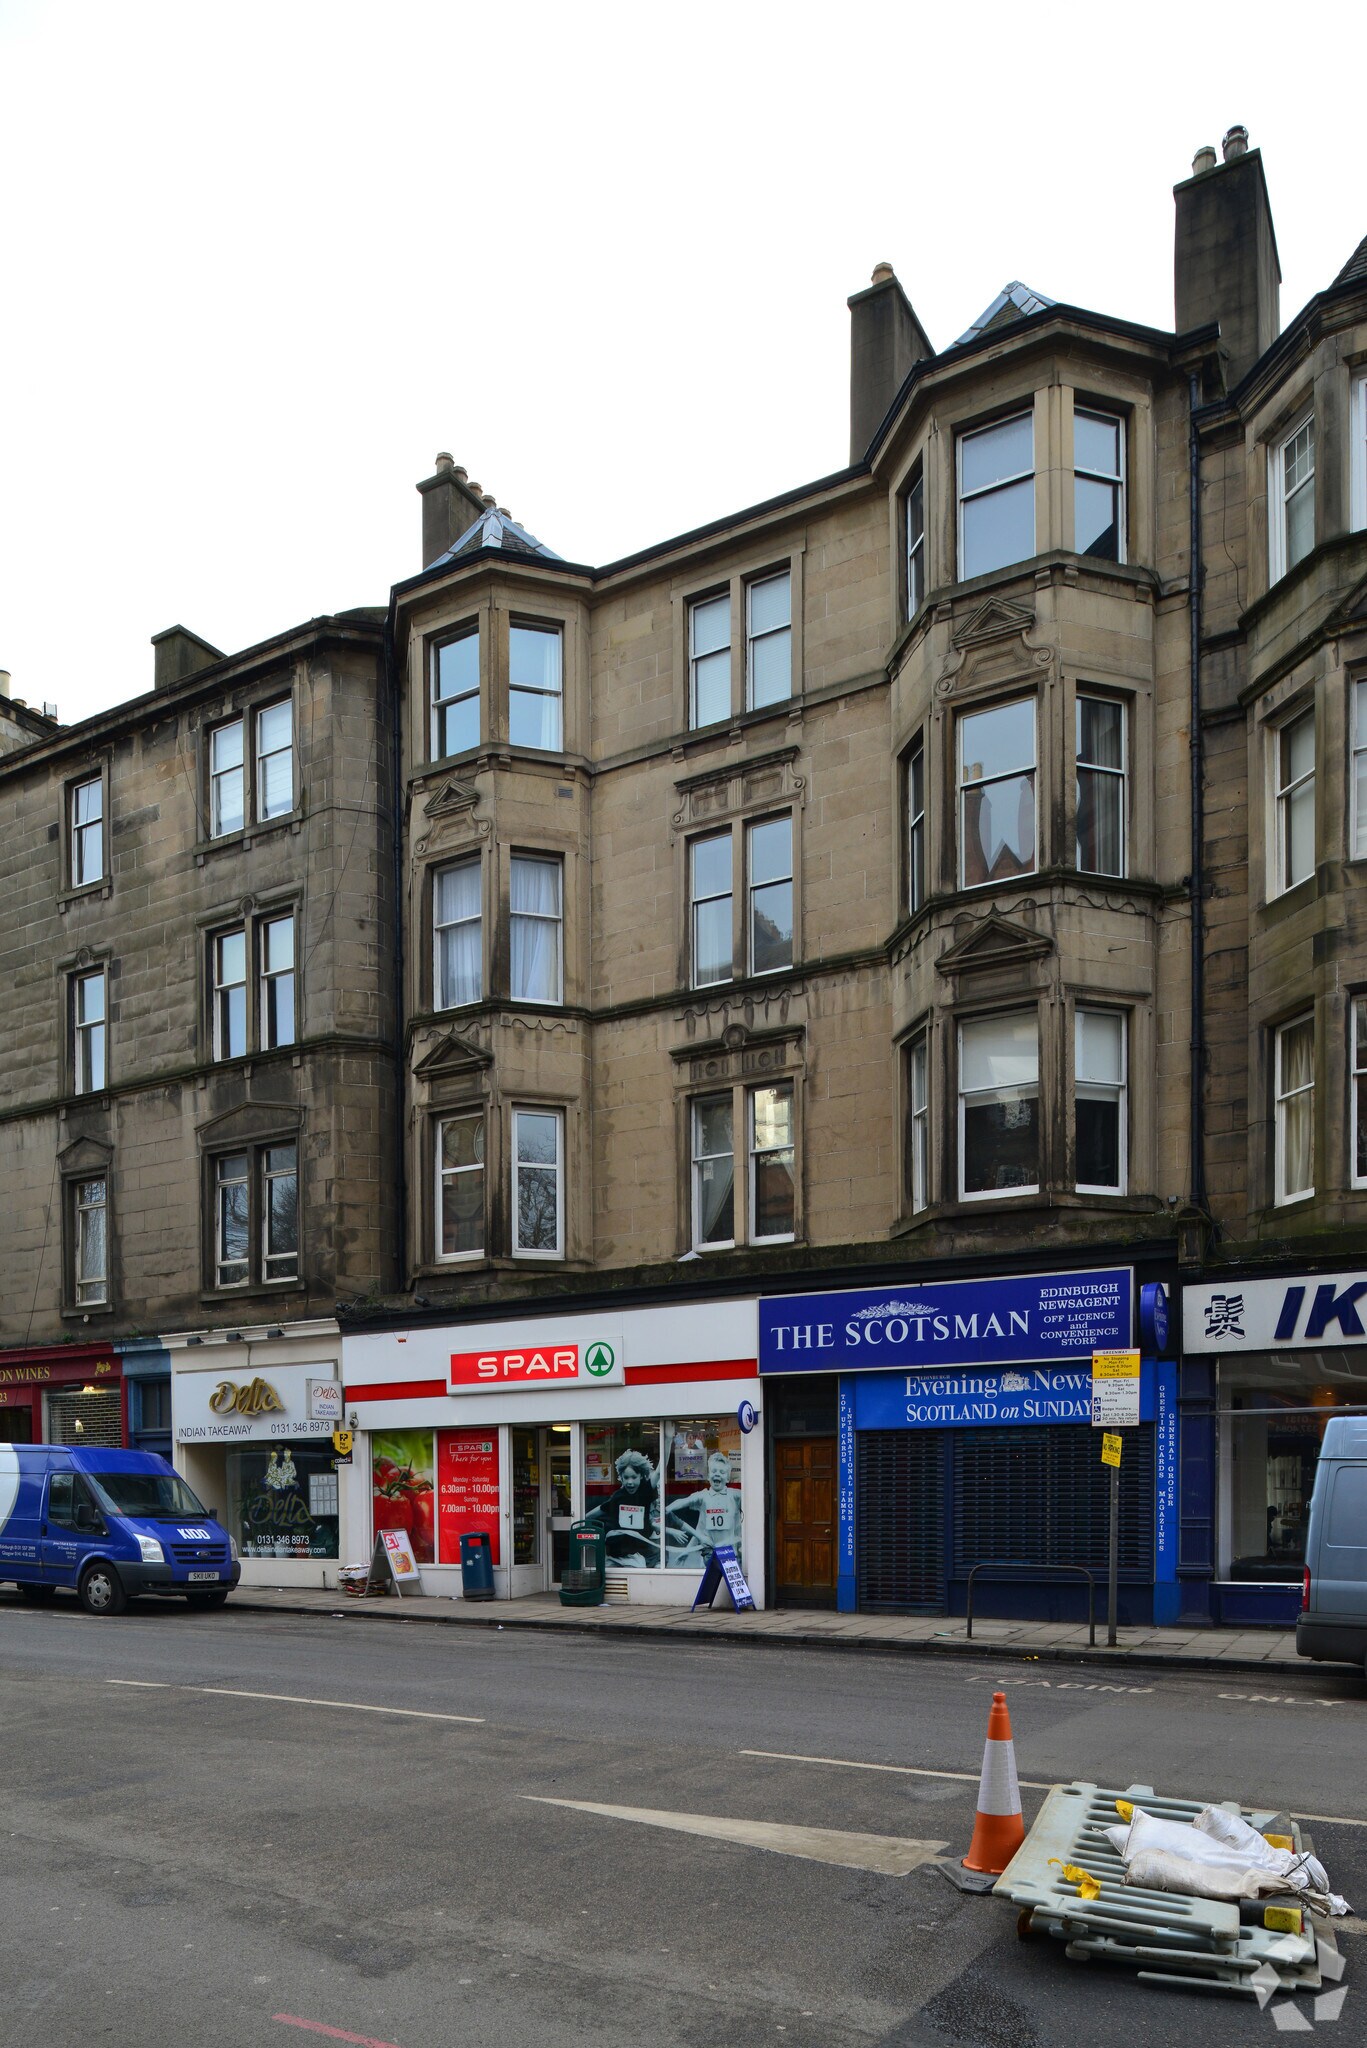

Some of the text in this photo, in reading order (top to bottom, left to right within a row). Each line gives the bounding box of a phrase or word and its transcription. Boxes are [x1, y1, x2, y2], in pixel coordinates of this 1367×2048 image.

[1040, 1283, 1119, 1298] EDINBURGH
[1038, 1296, 1120, 1311] NEWSAGENT
[1043, 1311, 1115, 1324] OFF LICENCE
[770, 1310, 1030, 1350] THE SCOTSMAN
[1069, 1321, 1088, 1330] and
[1040, 1327, 1119, 1340] CONVENIENCE
[1061, 1337, 1097, 1346] STORE
[478, 1351, 576, 1378] SPAR
[15, 1366, 51, 1381] WINES
[904, 1369, 1092, 1398] Evening News
[209, 1377, 286, 1416] Delta
[312, 1386, 340, 1399] Delta
[906, 1399, 1092, 1422] SCOTLAND on SUNDAY
[271, 1421, 331, 1435] 0131 346 8973
[840, 1417, 847, 1428] UP
[178, 1424, 253, 1438] INDIAN TAKEAWAY
[457, 1444, 482, 1452] SPAR
[451, 1453, 492, 1465] There for you
[441, 1484, 467, 1494] 6.30am
[249, 1493, 316, 1526] Delta
[441, 1504, 467, 1513] 7.00am
[628, 1514, 633, 1526] 1
[710, 1515, 724, 1527] 10
[1158, 1491, 1166, 1551] MAGAZINES
[176, 1528, 211, 1540] KIDD
[257, 1535, 310, 1545] 0131 346 8973
[242, 1545, 326, 1555] www.deltaindiantakeaway.com
[964, 1675, 1348, 1708] LOADING ONLY
